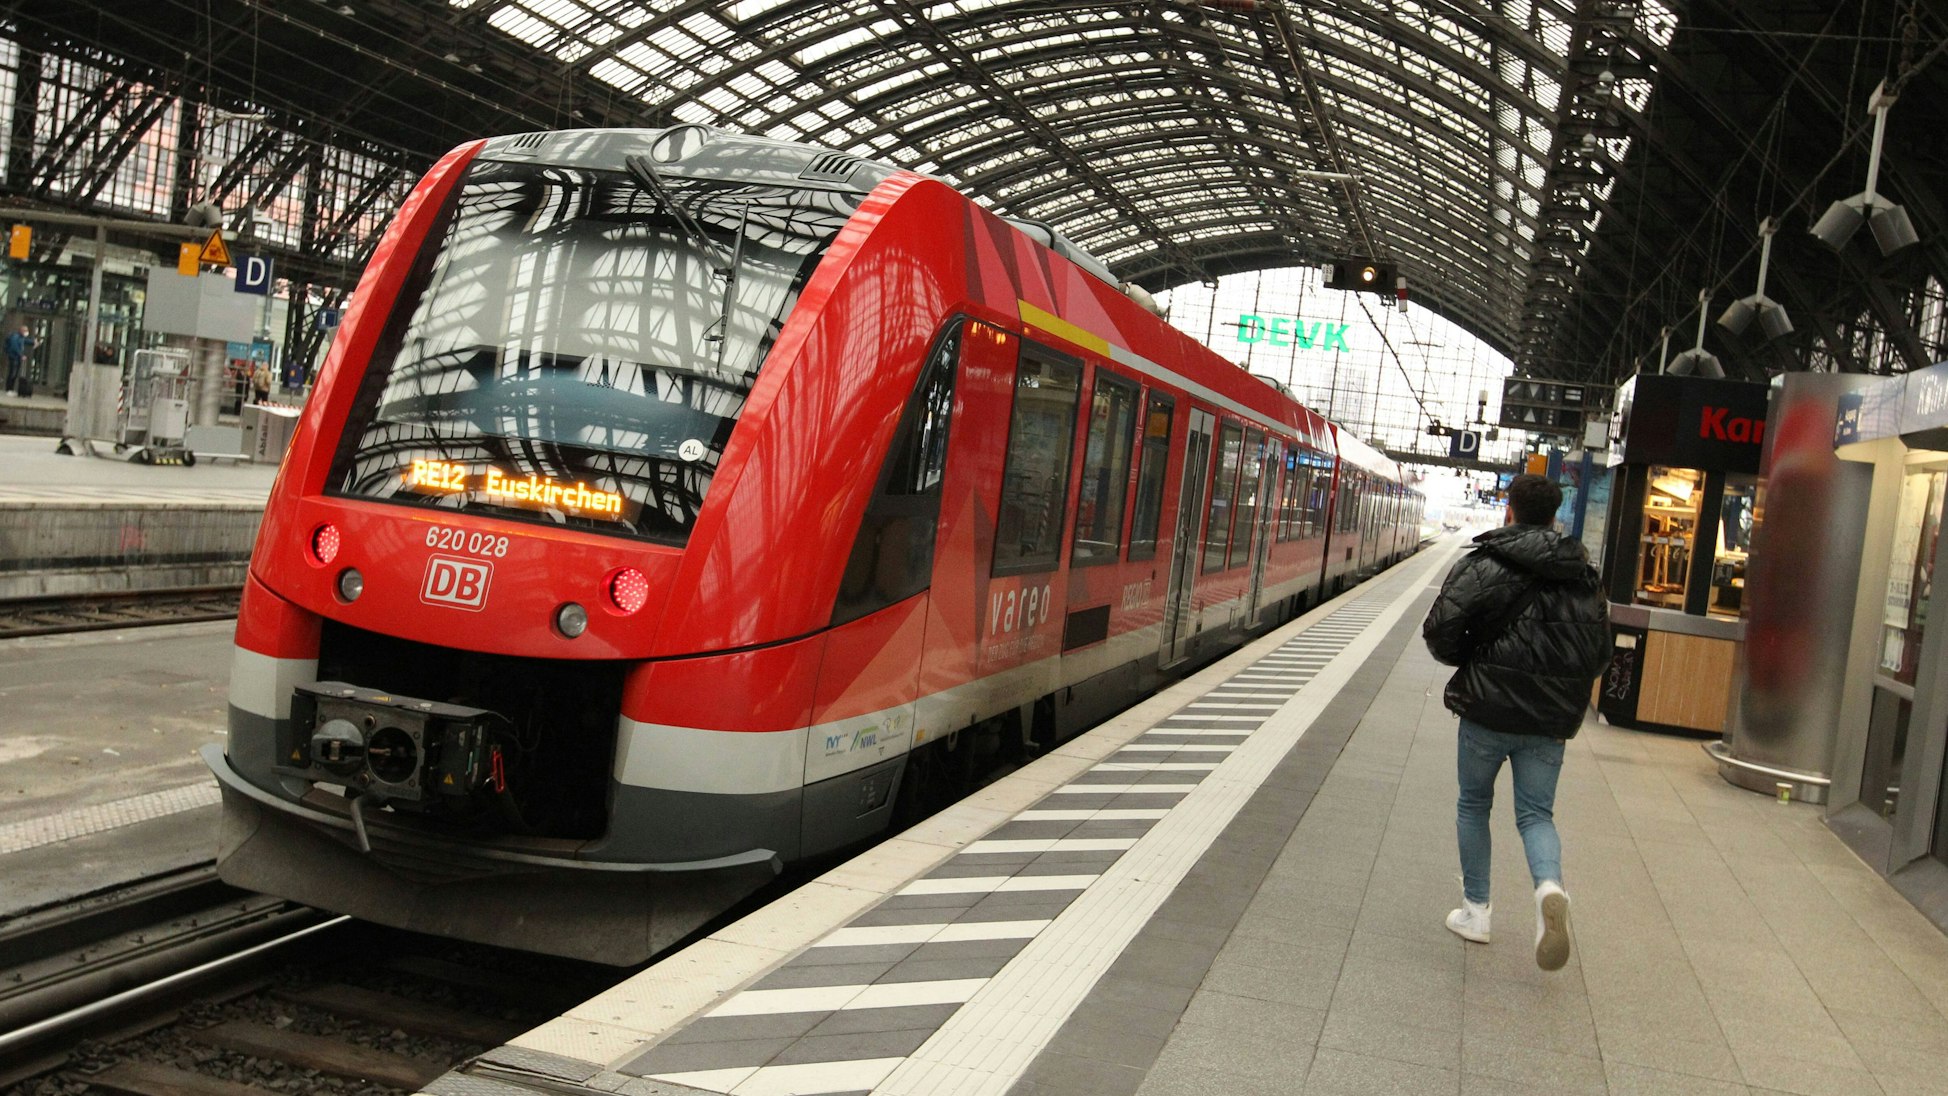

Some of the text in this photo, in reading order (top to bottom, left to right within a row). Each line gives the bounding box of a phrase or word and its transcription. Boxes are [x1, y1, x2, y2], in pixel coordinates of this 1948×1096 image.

[246, 256, 266, 286] D
[1237, 314, 1350, 353] DEVK
[683, 445, 698, 456] AL
[1459, 431, 1477, 453] D
[413, 459, 622, 513] RE12 Euskirchen
[425, 526, 509, 558] 620 028
[427, 561, 486, 604] DB
[992, 584, 1051, 636] vareo
